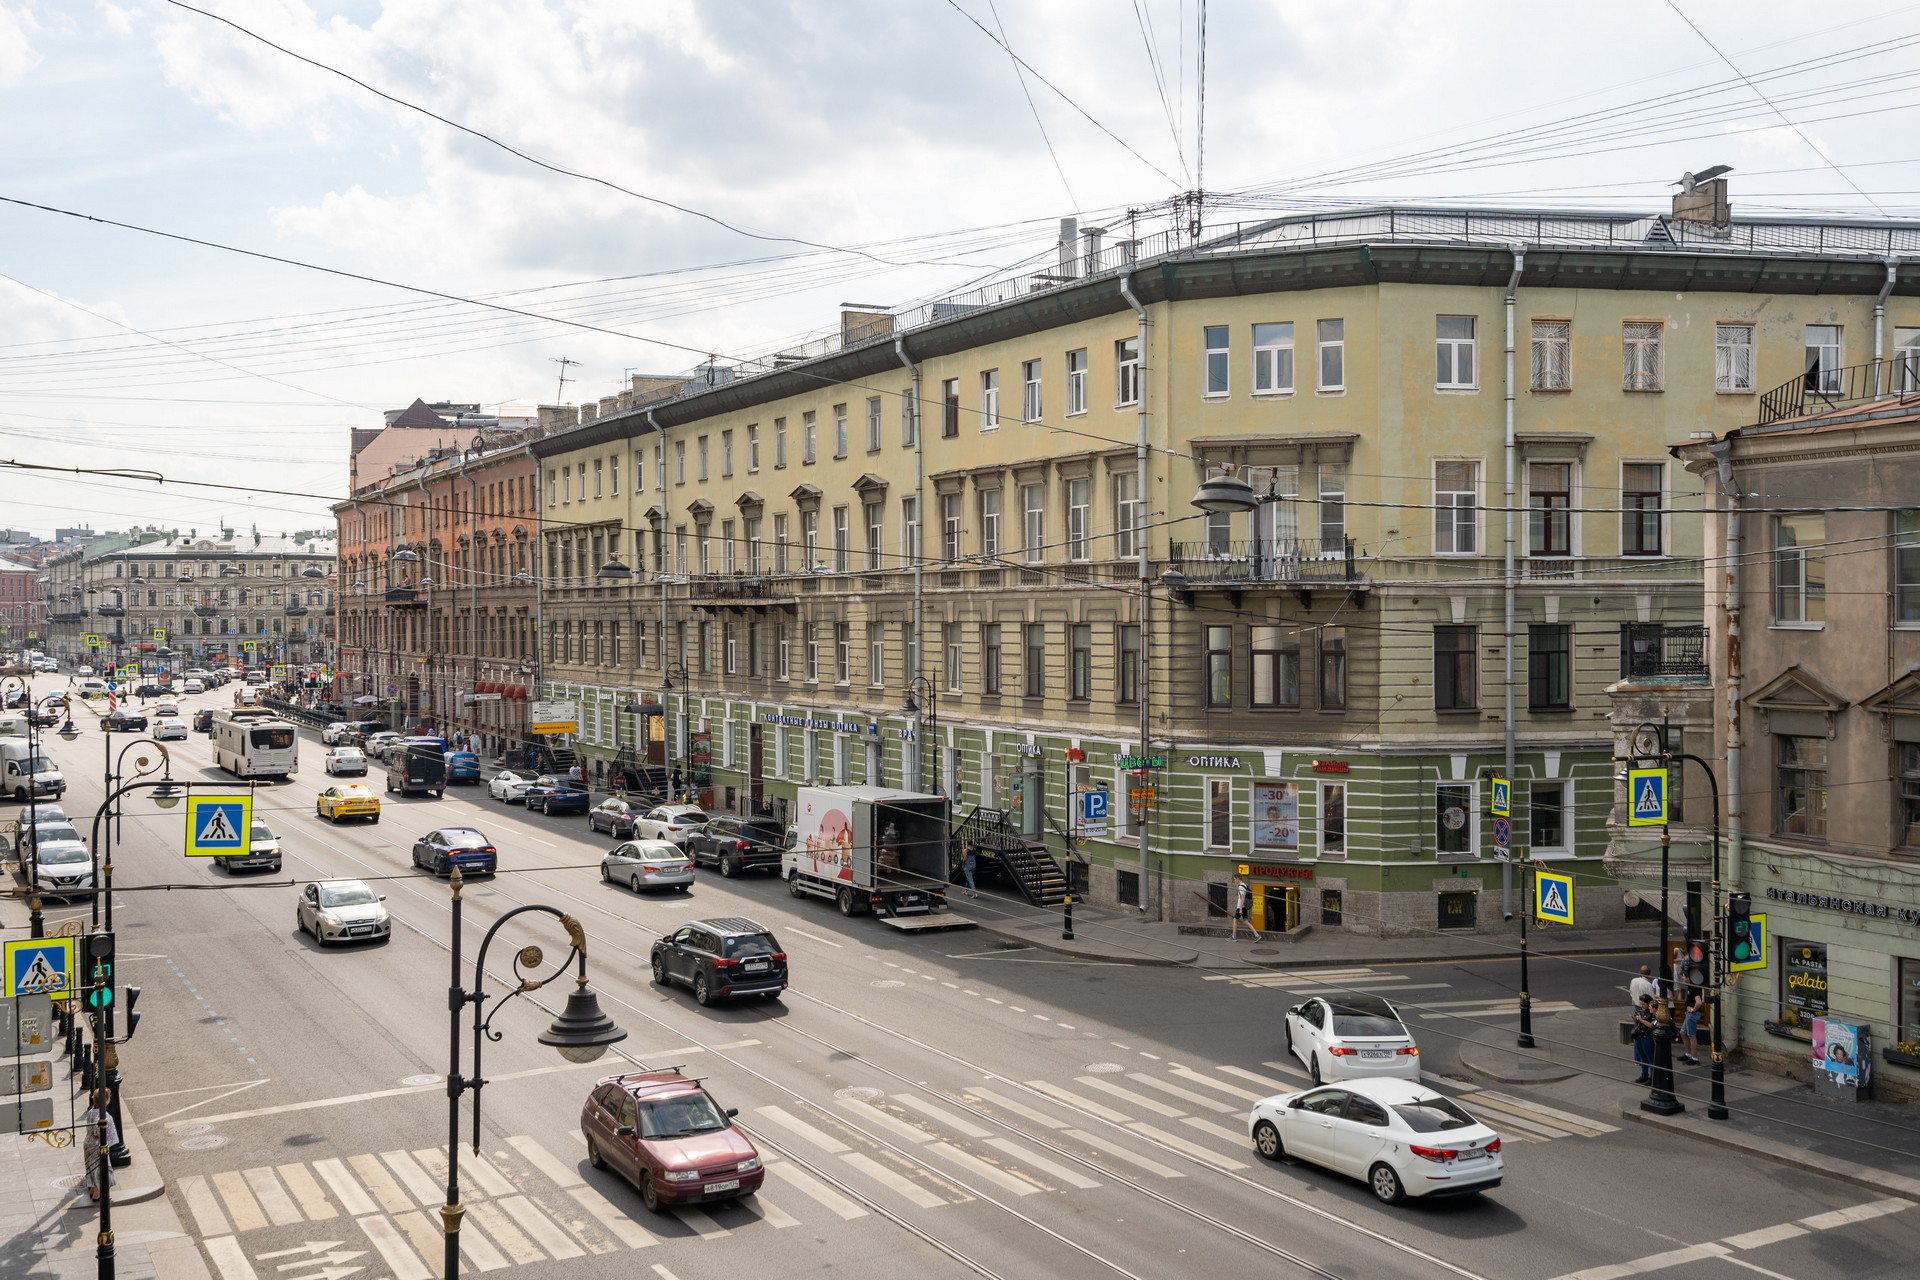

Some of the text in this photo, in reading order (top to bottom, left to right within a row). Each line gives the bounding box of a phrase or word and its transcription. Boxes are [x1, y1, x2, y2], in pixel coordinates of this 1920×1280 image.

[764, 713, 858, 732] КОНТАКТНЫЕ ЛИНЗЫ ОПТИКА
[1016, 743, 1041, 755] ОПТИКА
[1121, 756, 1162, 770] ЦВЕТЫ
[1189, 755, 1241, 768] ОПТИКА
[1251, 865, 1313, 878] ПРОДУКТЫ
[1766, 887, 1887, 917] итальянская
[1791, 957, 1823, 969] LA PASTA
[1788, 971, 1828, 991] gelato
